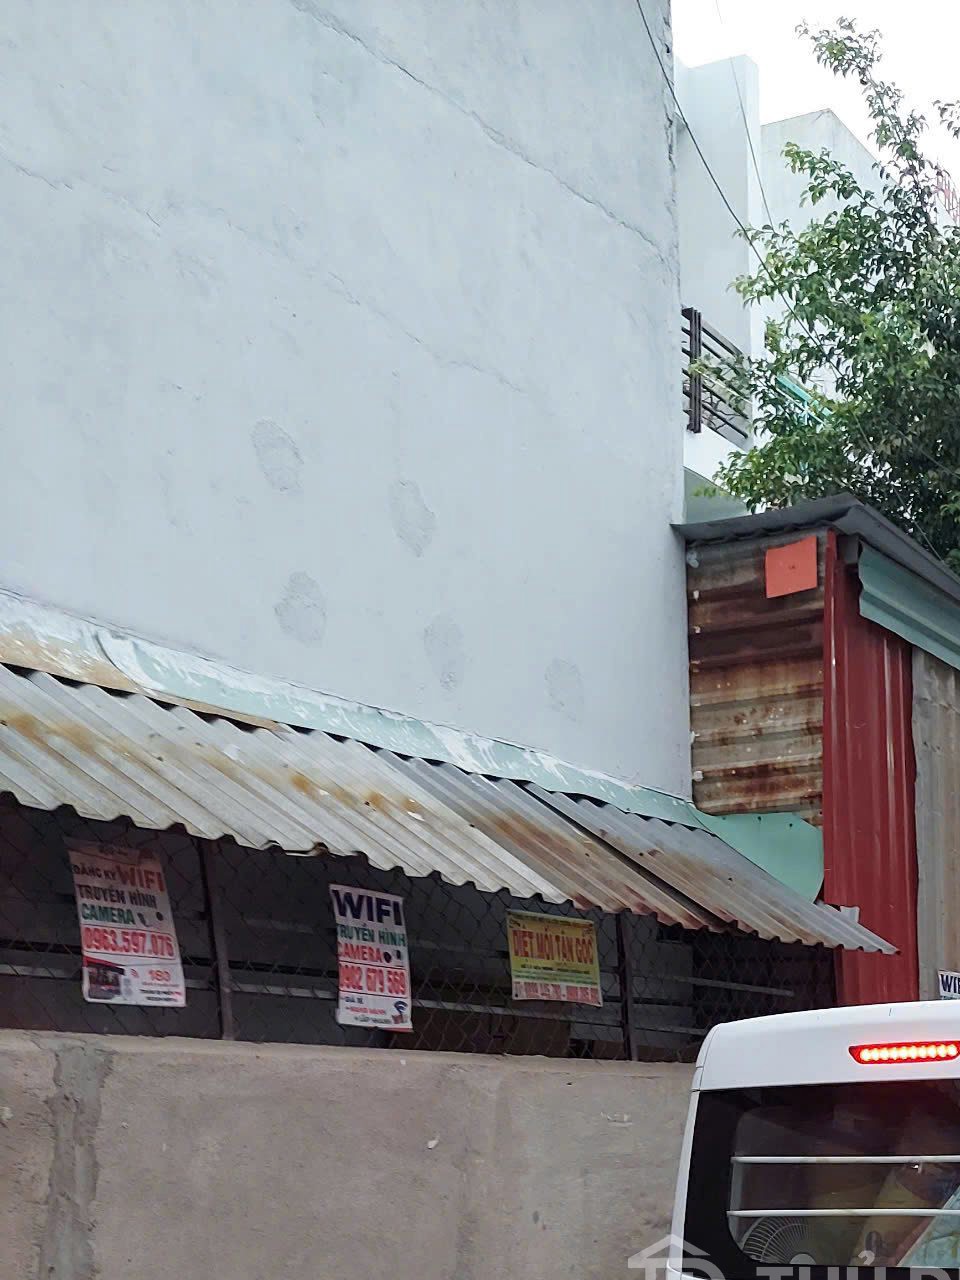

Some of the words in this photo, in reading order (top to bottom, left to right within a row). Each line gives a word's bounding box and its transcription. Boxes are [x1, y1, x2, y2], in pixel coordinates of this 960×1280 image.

[116, 865, 166, 893] WIFI
[81, 903, 136, 926] CAMERA
[332, 889, 403, 927] WIFI
